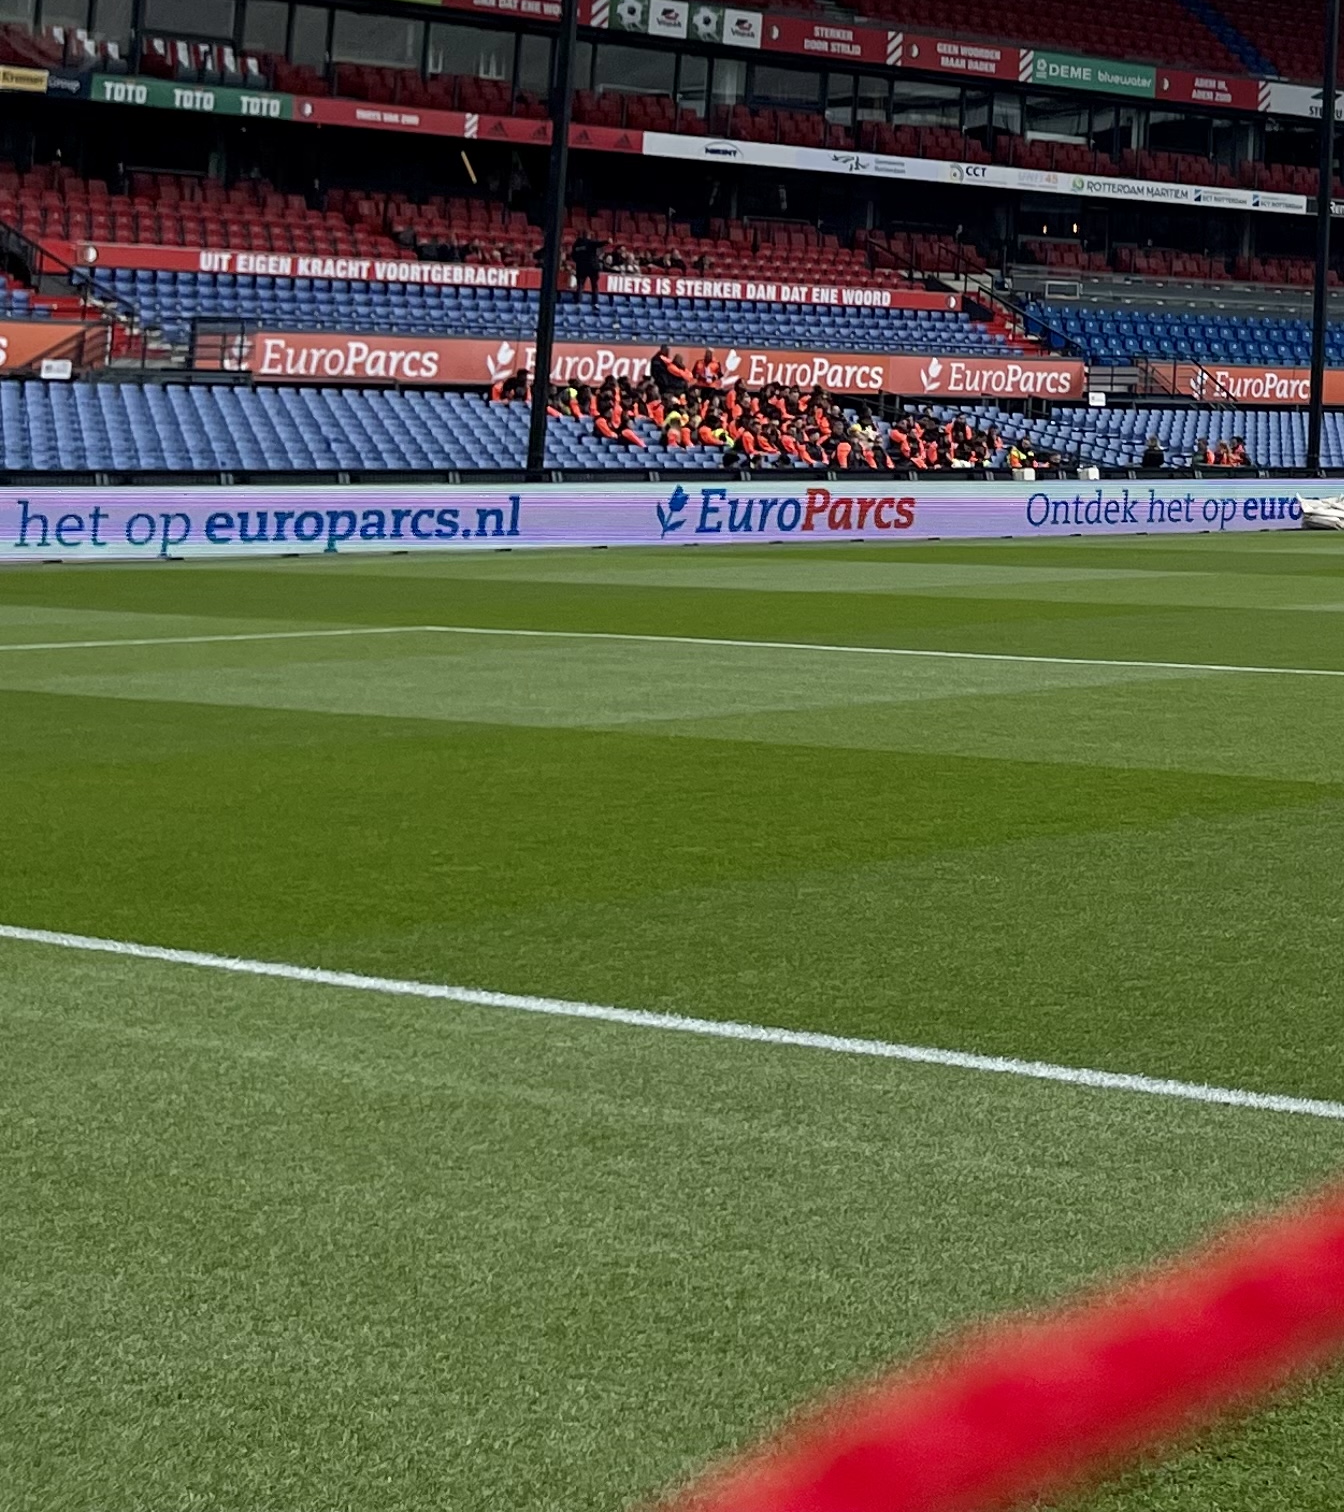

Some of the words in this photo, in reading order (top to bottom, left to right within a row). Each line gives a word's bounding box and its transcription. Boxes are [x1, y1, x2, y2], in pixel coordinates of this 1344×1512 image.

[1048, 61, 1093, 81] DEME
[1097, 69, 1153, 89] bluewater
[103, 80, 148, 105] TOTO
[174, 88, 215, 112] TOTO
[240, 95, 282, 119] TOTO
[965, 165, 987, 180] CCT
[1087, 180, 1145, 198] ROTTERDAM
[1146, 186, 1189, 200] MARITIEM
[200, 250, 232, 273] UIT
[236, 253, 293, 276] EIGEN
[298, 257, 373, 280] KRACHT
[374, 262, 520, 288] VOORTGEBRACHT
[607, 274, 652, 295] NIETS
[656, 279, 672, 296] IS
[675, 280, 743, 301] STERKER
[745, 284, 777, 303] DAN
[780, 286, 808, 304] DAT
[811, 288, 839, 306] ENE
[841, 289, 892, 307] WOORD
[258, 338, 440, 378] EuroParcs
[746, 354, 884, 390] EuroParcs
[947, 362, 1072, 394] EuroParcs
[1211, 370, 1310, 400] EuroParc
[695, 487, 916, 534] EuroParcs
[1026, 489, 1139, 528] Ontdek
[1147, 488, 1195, 525] het
[1202, 500, 1237, 531] op
[15, 499, 110, 548] het
[126, 512, 192, 558] op
[205, 494, 522, 553] europarcs.nl
